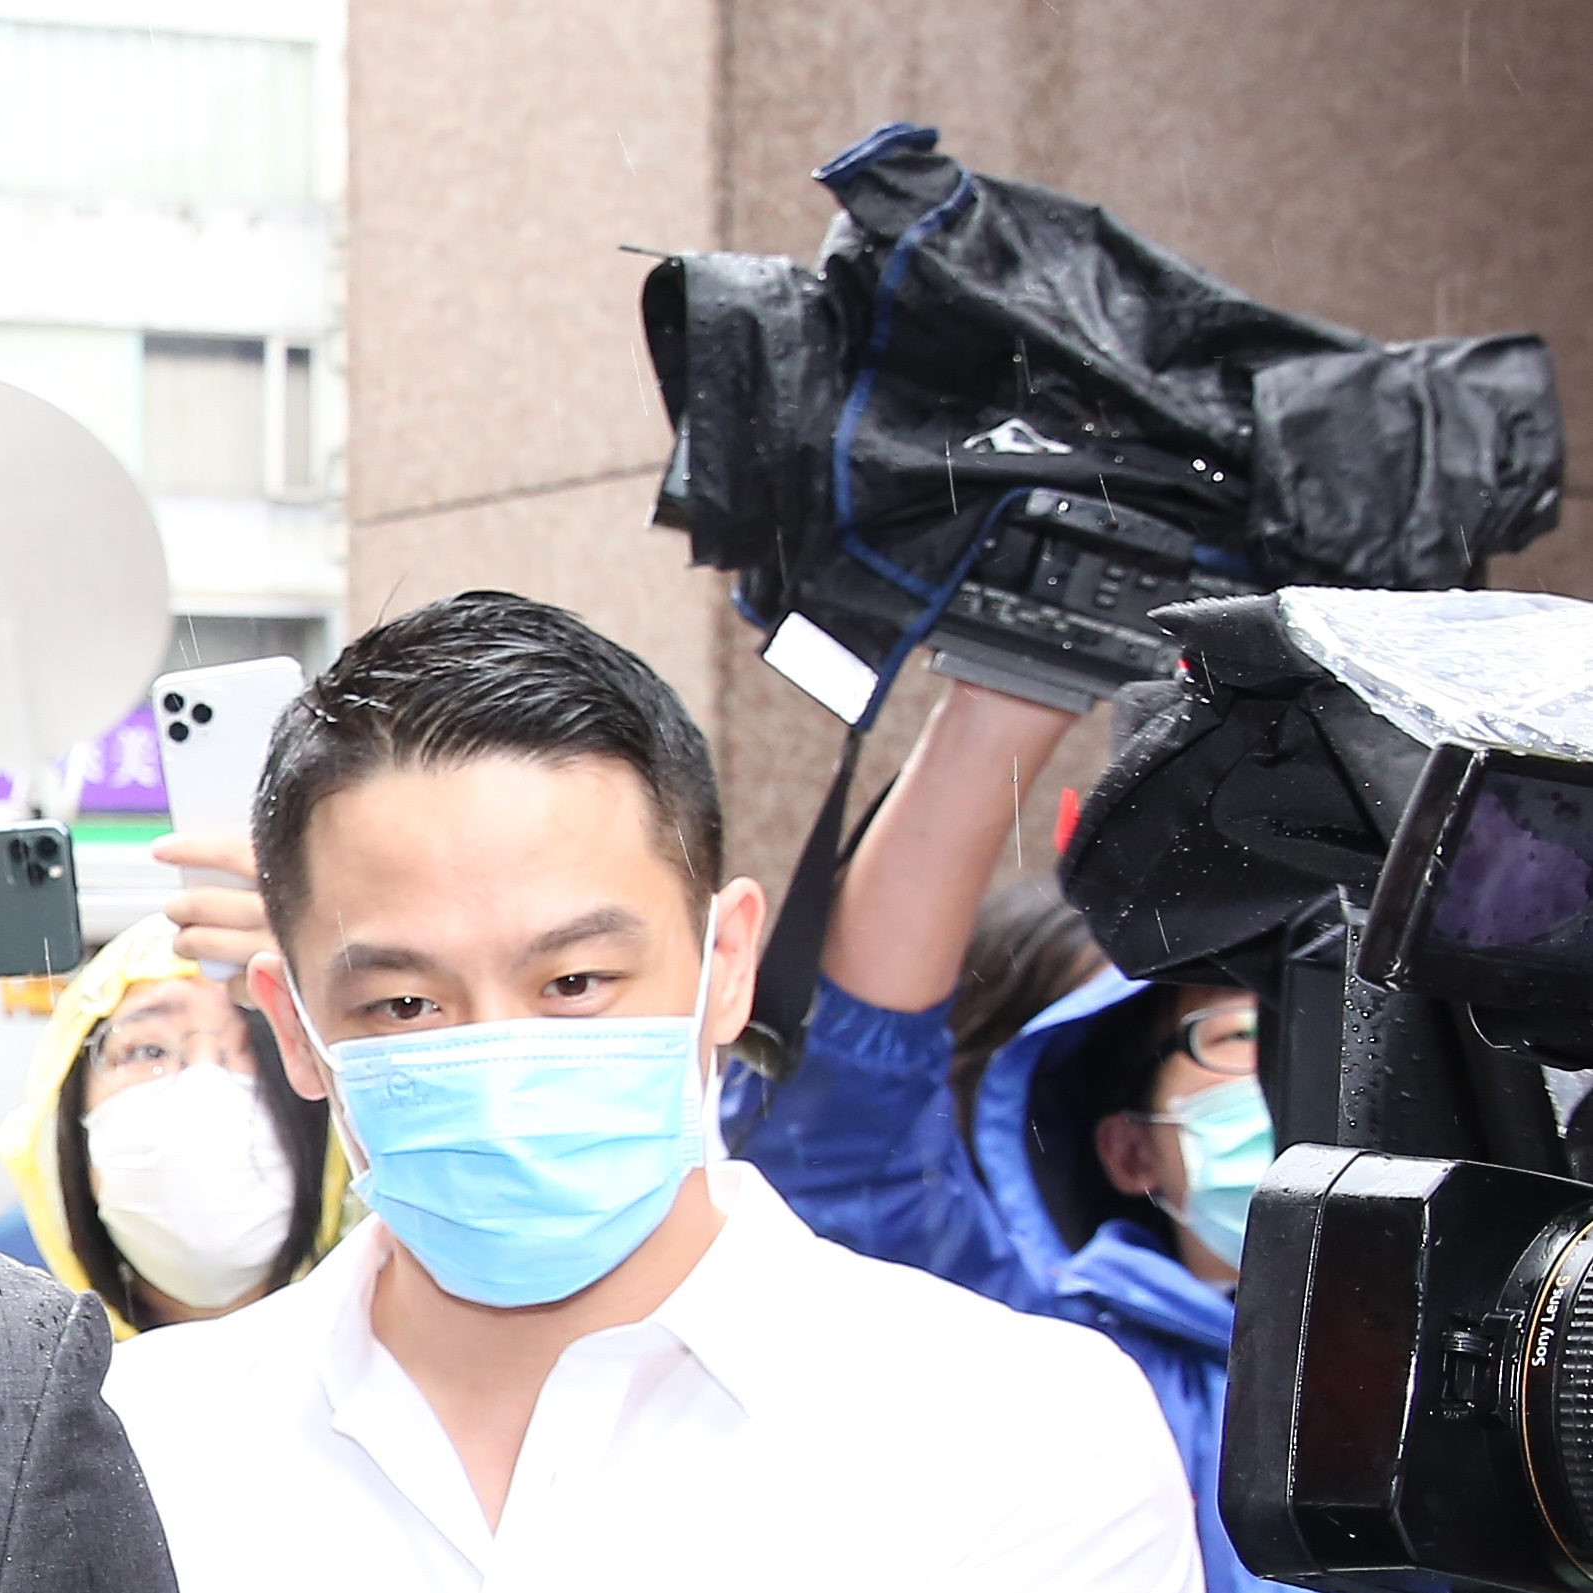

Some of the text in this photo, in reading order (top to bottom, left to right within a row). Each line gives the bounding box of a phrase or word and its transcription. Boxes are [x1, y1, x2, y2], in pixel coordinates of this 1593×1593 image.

[1531, 1275, 1571, 1366] Sony Lens G
